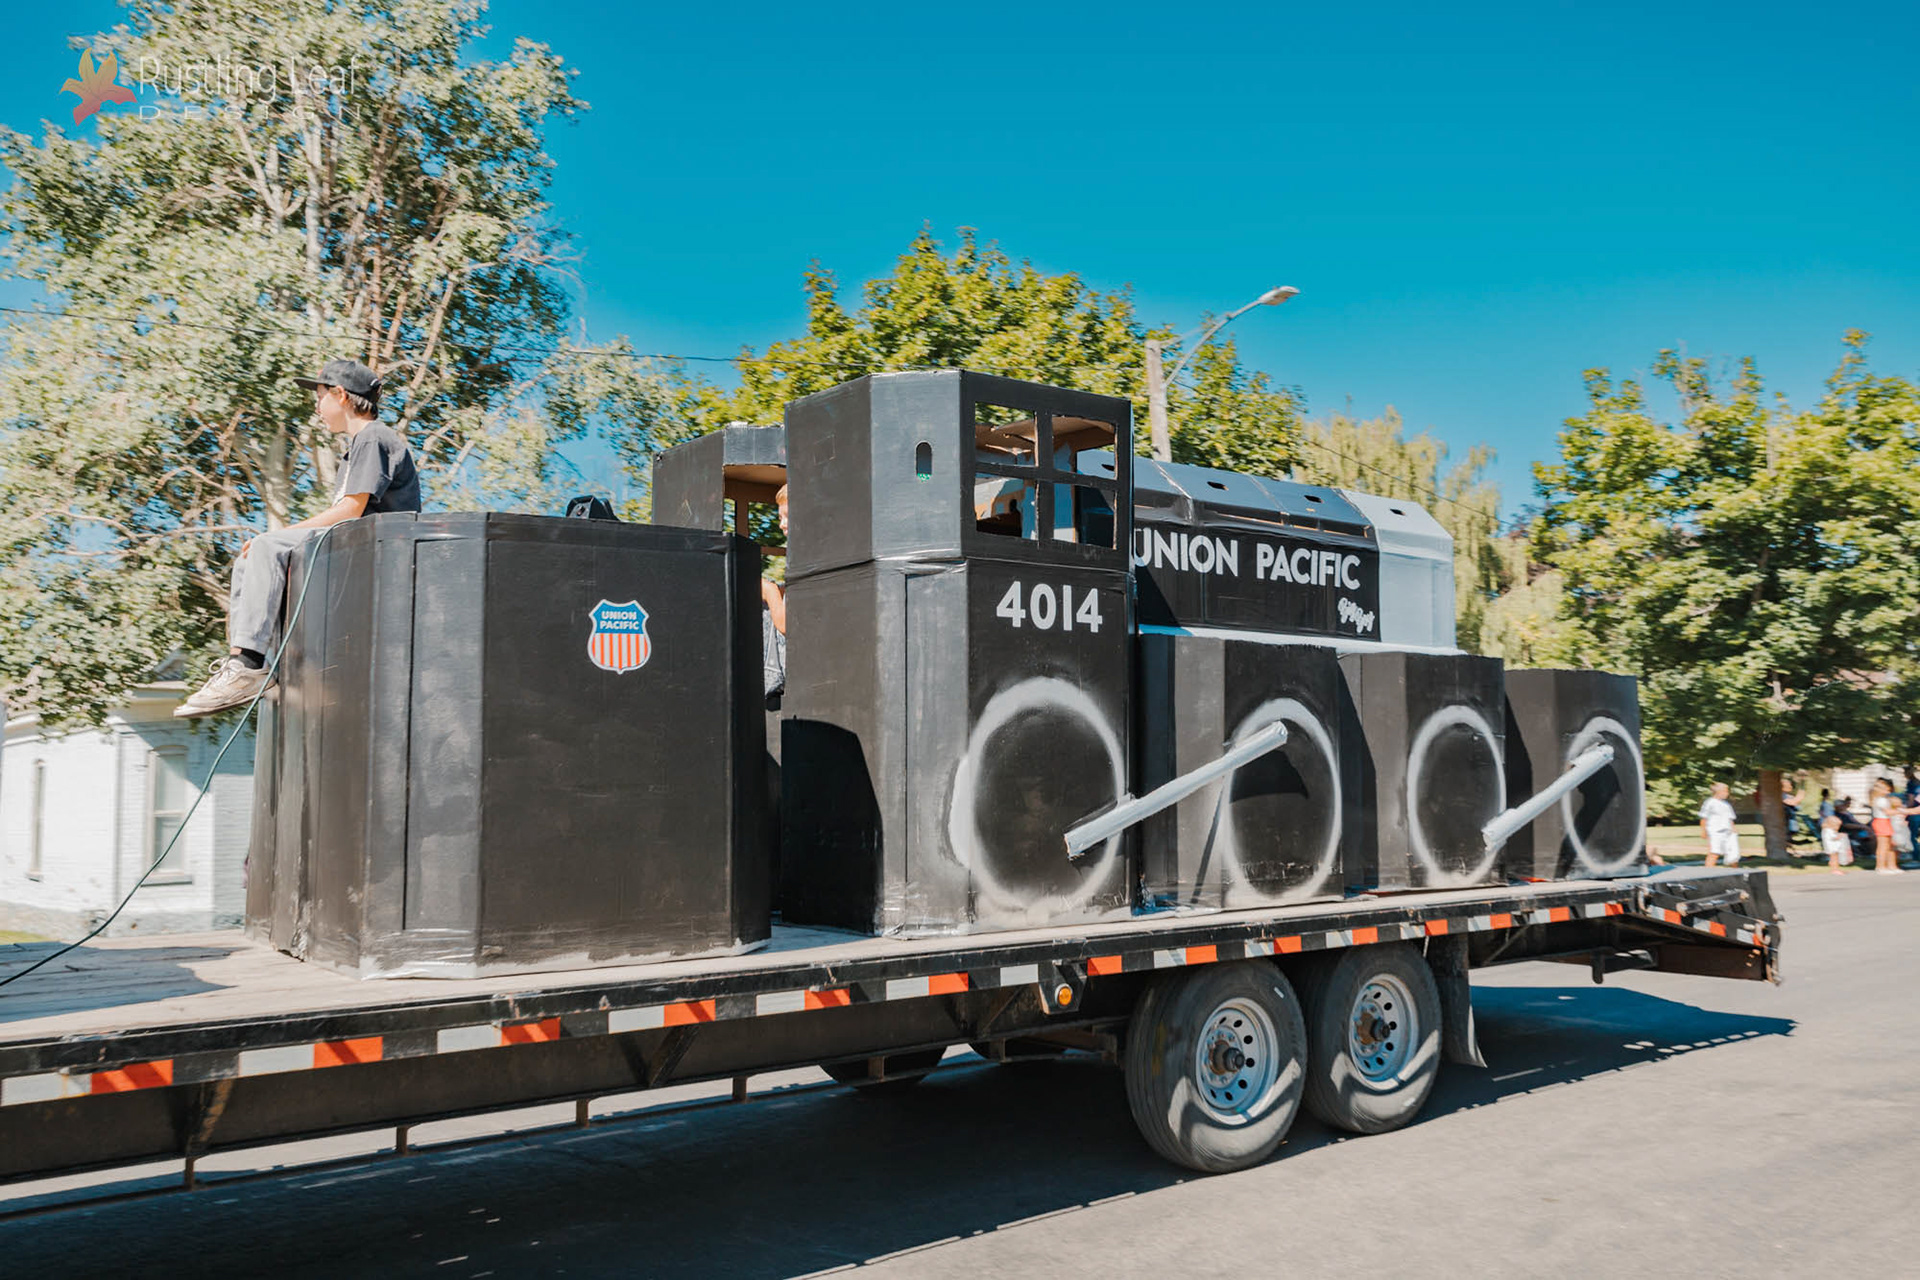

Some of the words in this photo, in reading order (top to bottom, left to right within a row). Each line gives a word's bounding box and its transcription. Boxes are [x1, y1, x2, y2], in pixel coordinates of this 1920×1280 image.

[1133, 527, 1239, 577] UNION
[1256, 543, 1361, 590] PACIFIC
[601, 611, 637, 620] UNION
[996, 580, 1103, 633] 4014
[600, 621, 640, 630] PACIFIC
